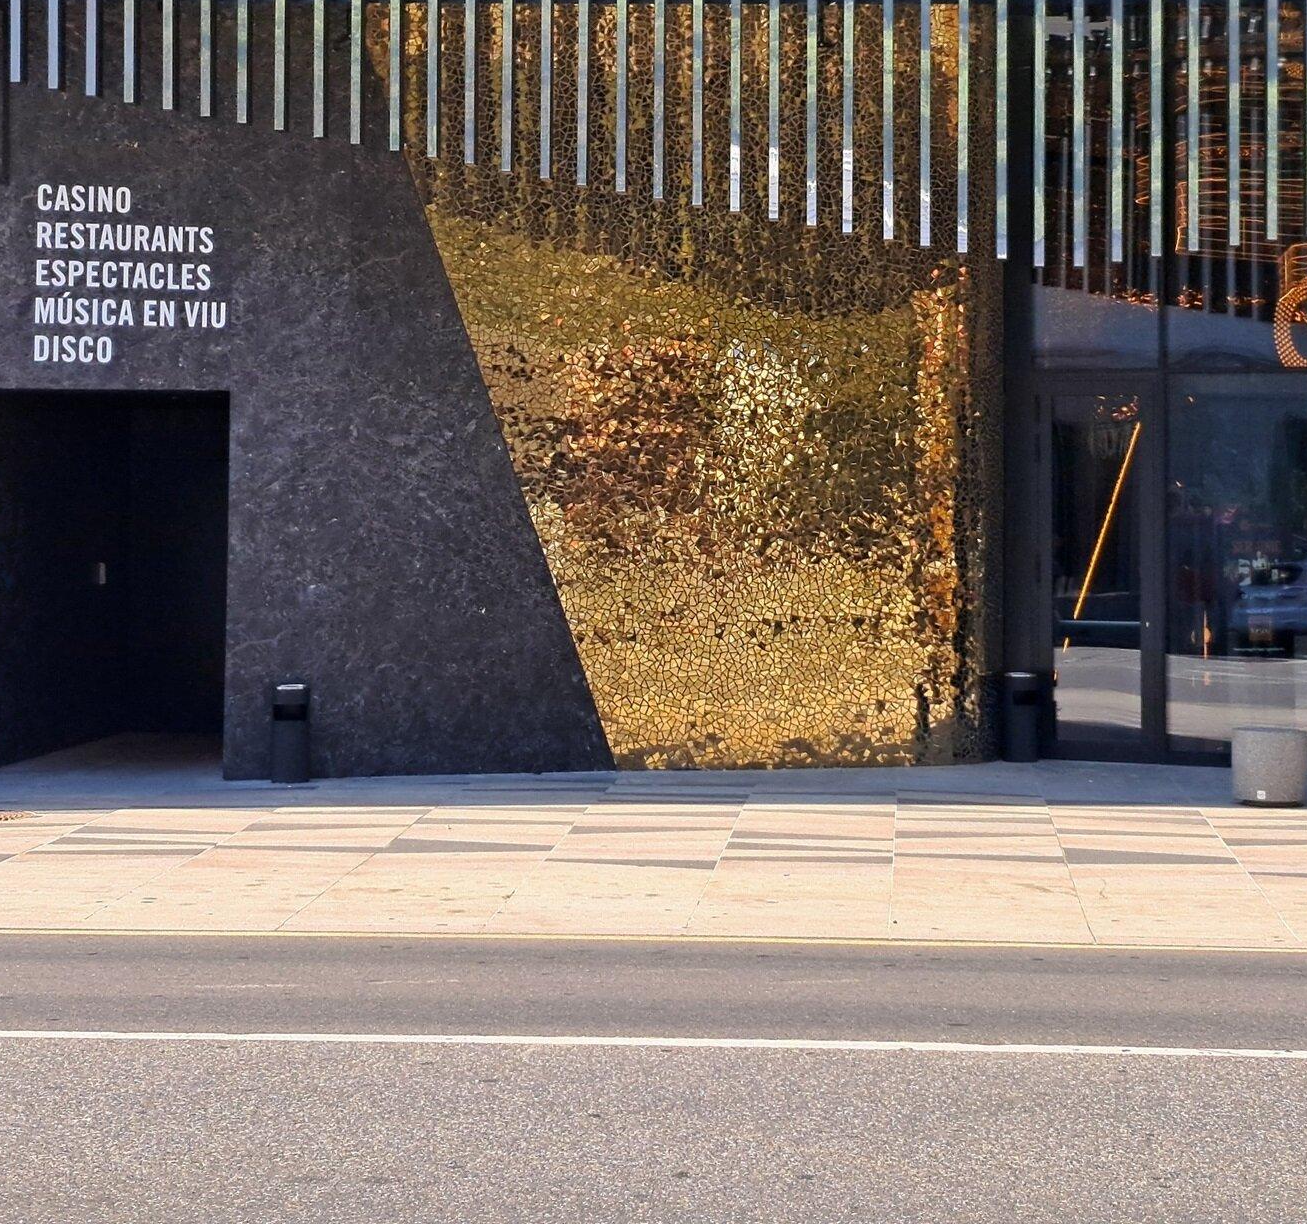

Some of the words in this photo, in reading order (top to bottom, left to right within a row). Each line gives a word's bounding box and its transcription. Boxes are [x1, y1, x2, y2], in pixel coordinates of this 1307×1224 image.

[37, 184, 131, 213] CASINO
[36, 222, 214, 253] RESTAURANTS
[35, 260, 211, 291] ESPECTACLES
[34, 292, 134, 325] MÚSICA
[143, 300, 175, 326] EN
[184, 302, 226, 328] VIU
[33, 335, 112, 363] DISCO
